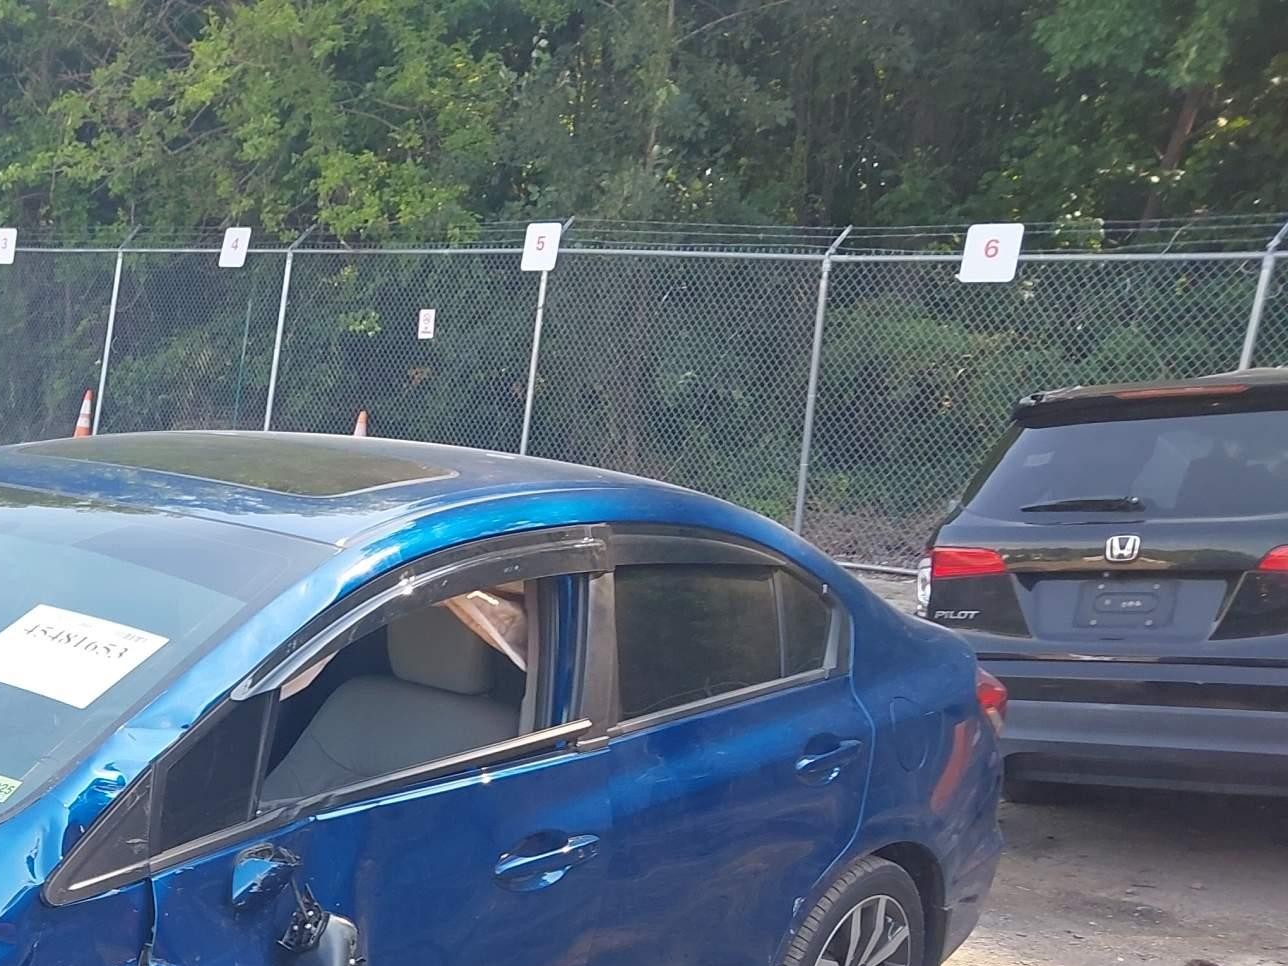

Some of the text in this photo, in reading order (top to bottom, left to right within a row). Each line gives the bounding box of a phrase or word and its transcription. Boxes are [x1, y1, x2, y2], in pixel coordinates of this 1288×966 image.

[1, 238, 8, 249] 3
[231, 237, 240, 250] 4
[536, 235, 546, 251] 5
[984, 239, 1000, 258] 6
[934, 610, 980, 619] PILOT
[23, 624, 129, 659] 45481653
